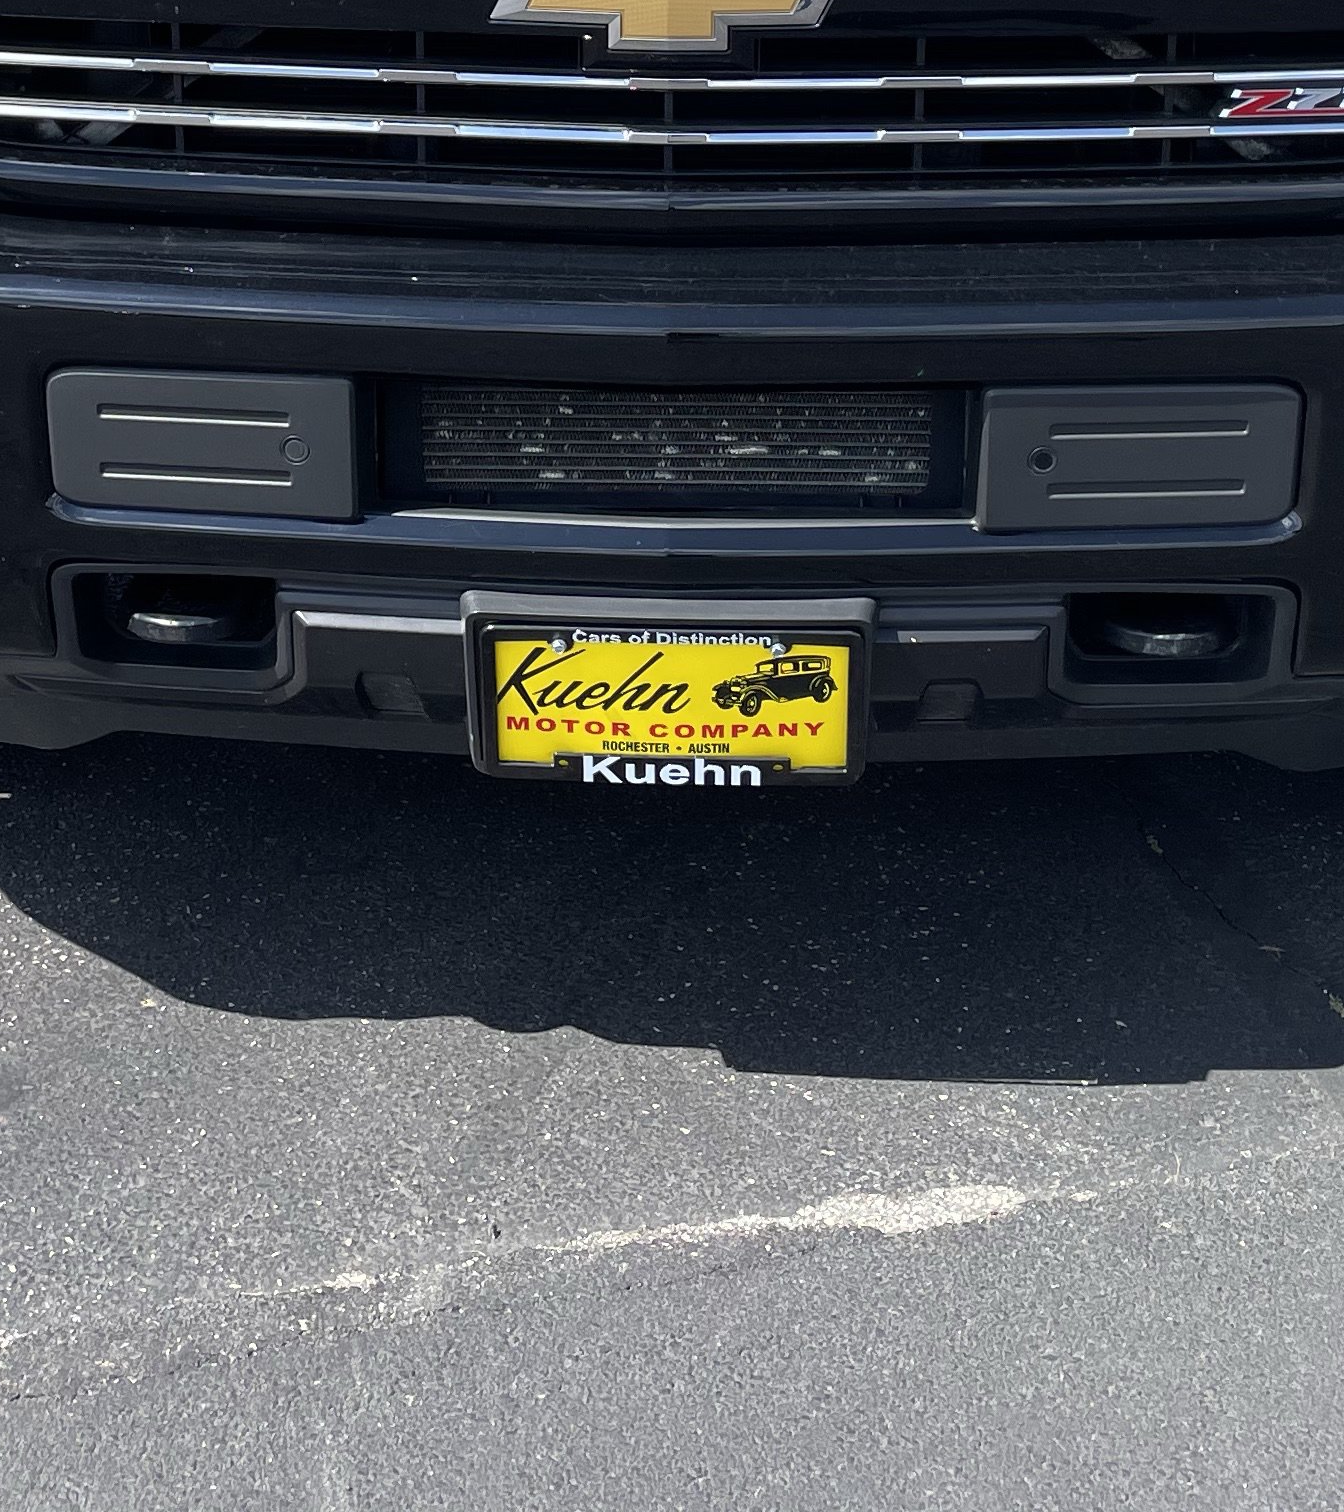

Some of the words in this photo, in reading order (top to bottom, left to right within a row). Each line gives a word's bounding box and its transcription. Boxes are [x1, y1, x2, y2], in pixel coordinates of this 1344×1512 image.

[572, 628, 621, 645] Cars
[628, 629, 651, 645] of
[656, 630, 771, 646] Distinction
[497, 647, 691, 715] Kuehn
[506, 716, 631, 738] MOTOR
[649, 721, 825, 738] COMPANY
[602, 740, 670, 754] ROCHESTER
[688, 742, 730, 755] AUSTIN
[582, 755, 762, 787] Kuehn
